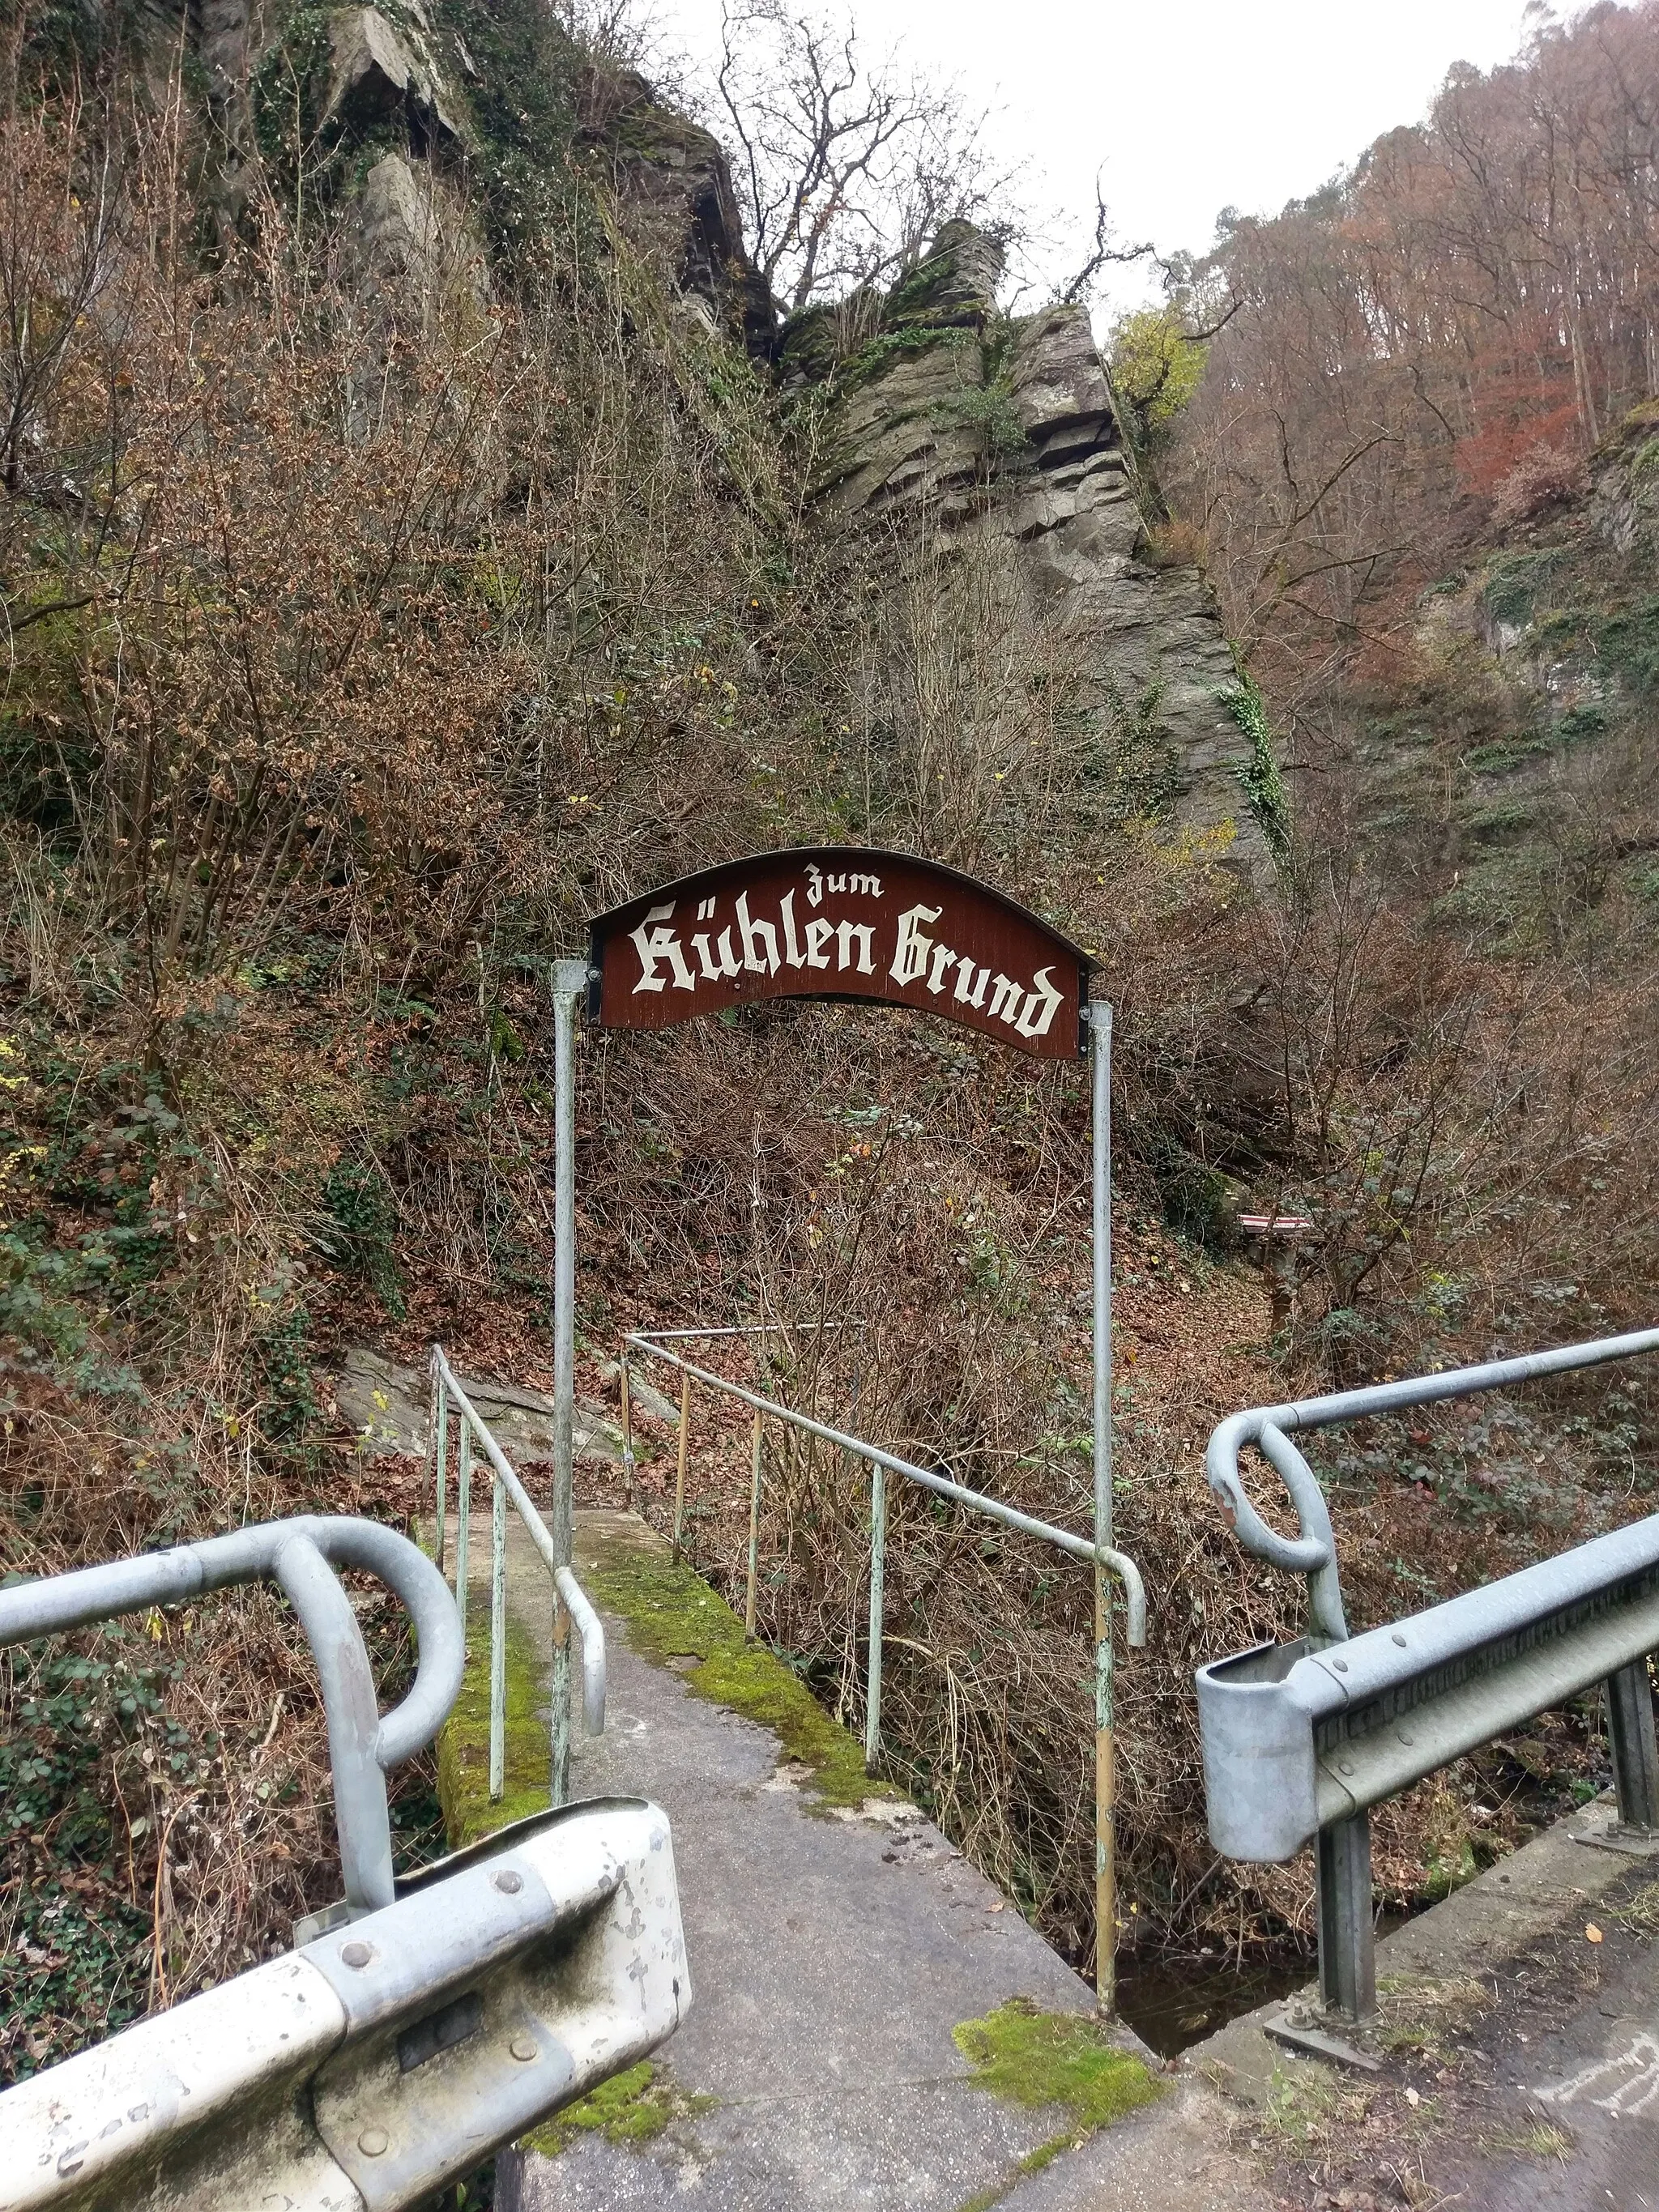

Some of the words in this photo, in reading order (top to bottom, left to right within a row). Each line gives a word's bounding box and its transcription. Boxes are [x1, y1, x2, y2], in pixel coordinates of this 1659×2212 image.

[804, 863, 885, 908] Zum
[628, 888, 877, 995] Kühlen
[889, 903, 1065, 1039] Grund
